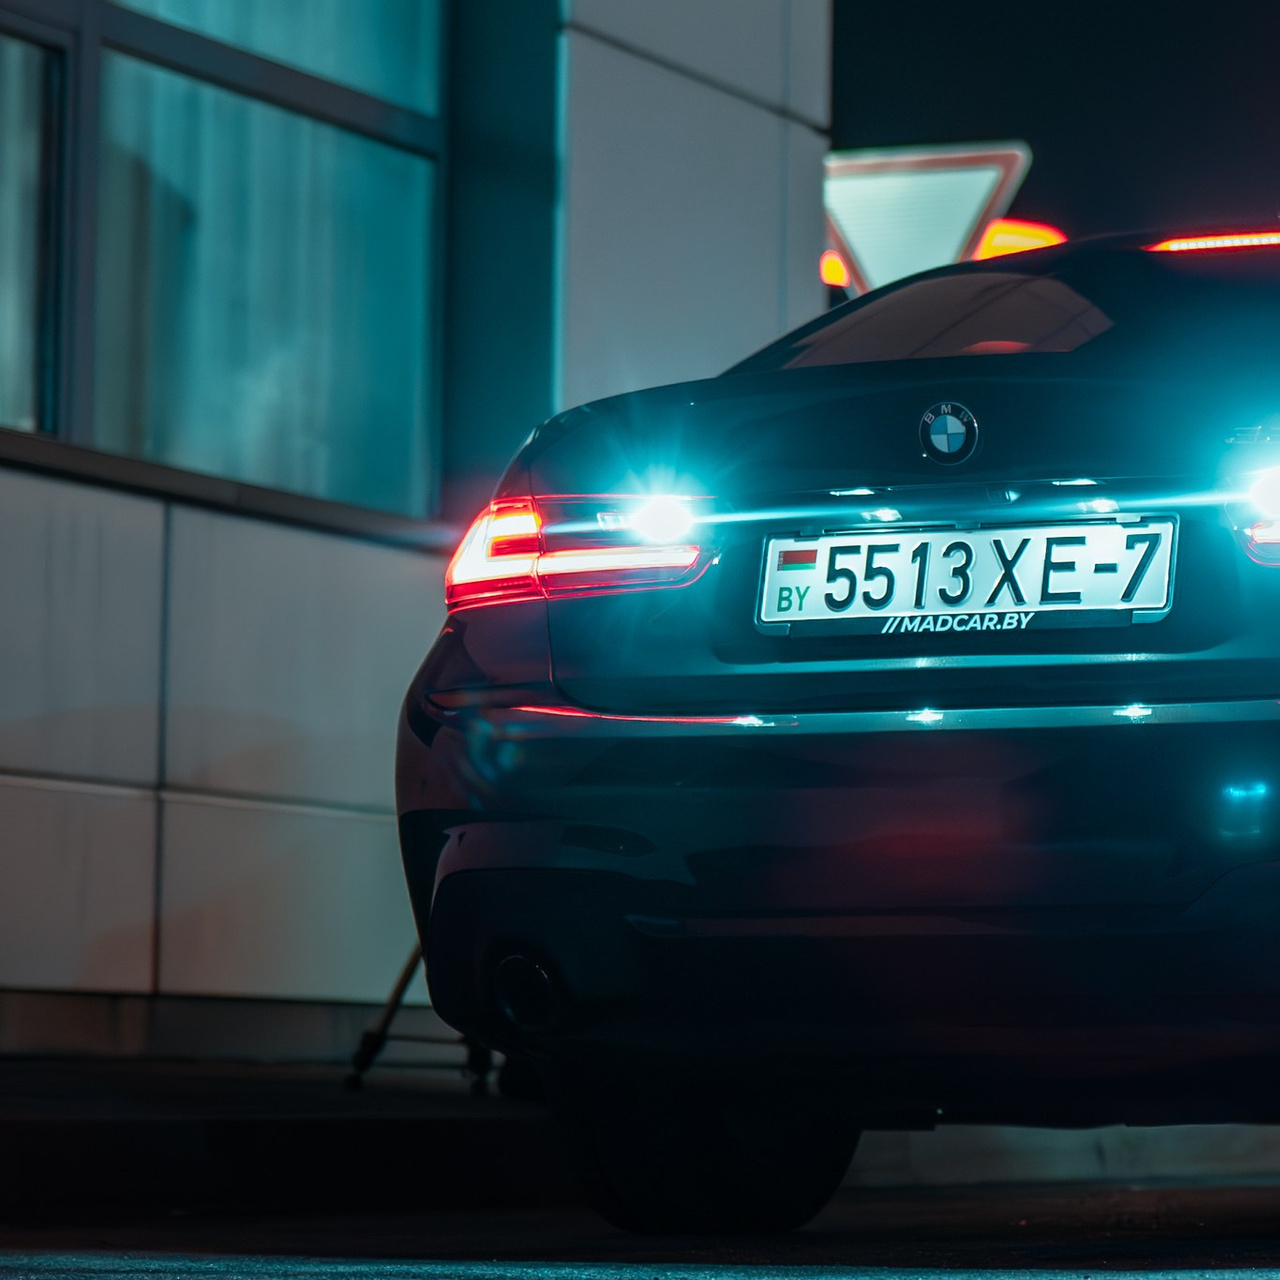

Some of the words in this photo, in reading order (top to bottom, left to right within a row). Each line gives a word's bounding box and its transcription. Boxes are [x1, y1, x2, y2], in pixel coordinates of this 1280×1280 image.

[924, 404, 971, 424] BMW
[824, 540, 974, 613] 5513
[984, 532, 1162, 608] XE-7
[777, 585, 811, 613] BY
